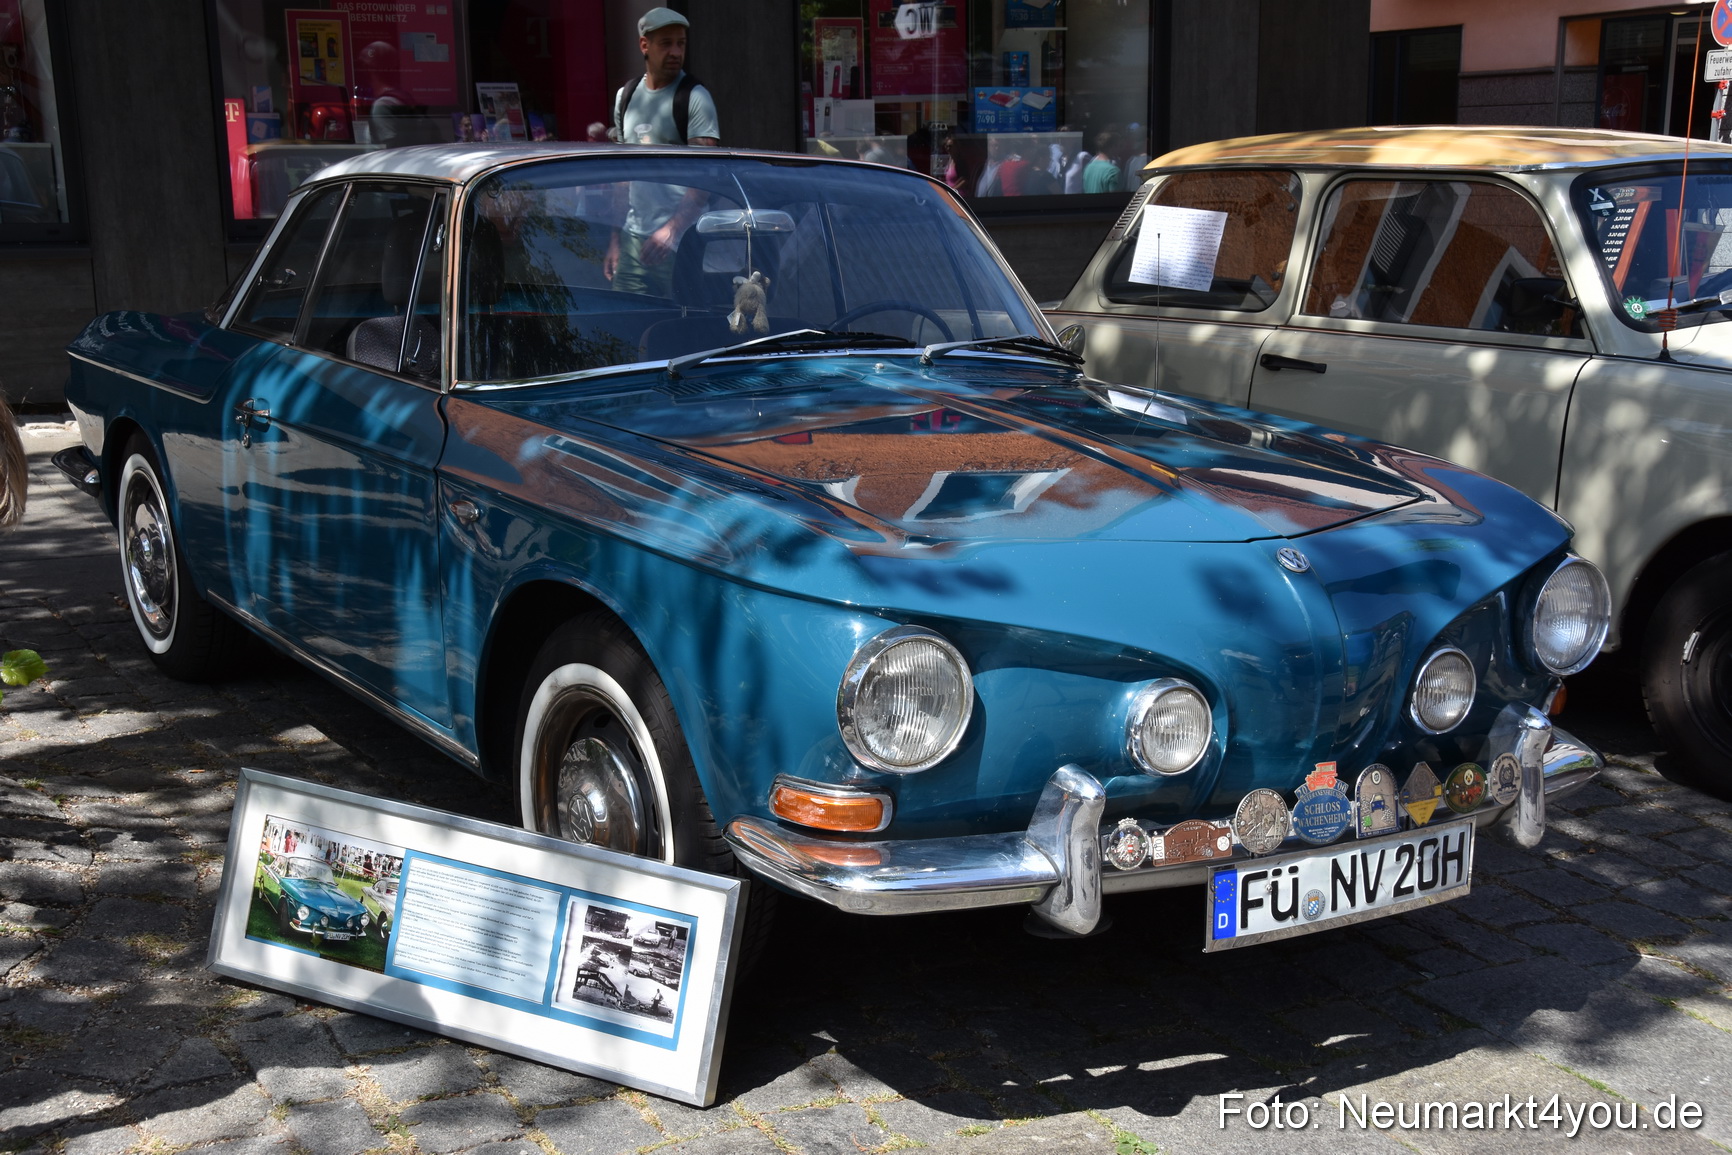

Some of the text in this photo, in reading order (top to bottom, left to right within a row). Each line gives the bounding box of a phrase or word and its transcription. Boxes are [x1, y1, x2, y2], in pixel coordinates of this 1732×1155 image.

[356, 3, 416, 13] FOTOWUNDER
[350, 13, 408, 23] BESTEN NETZ
[976, 114, 996, 124] 7490
[1304, 801, 1341, 816] SCHLOSS
[1297, 813, 1347, 828] WACHENHEIM
[1239, 865, 1299, 929] FÜ
[1330, 849, 1386, 912] NV
[1393, 832, 1465, 899] 20H
[1218, 912, 1229, 929] D
